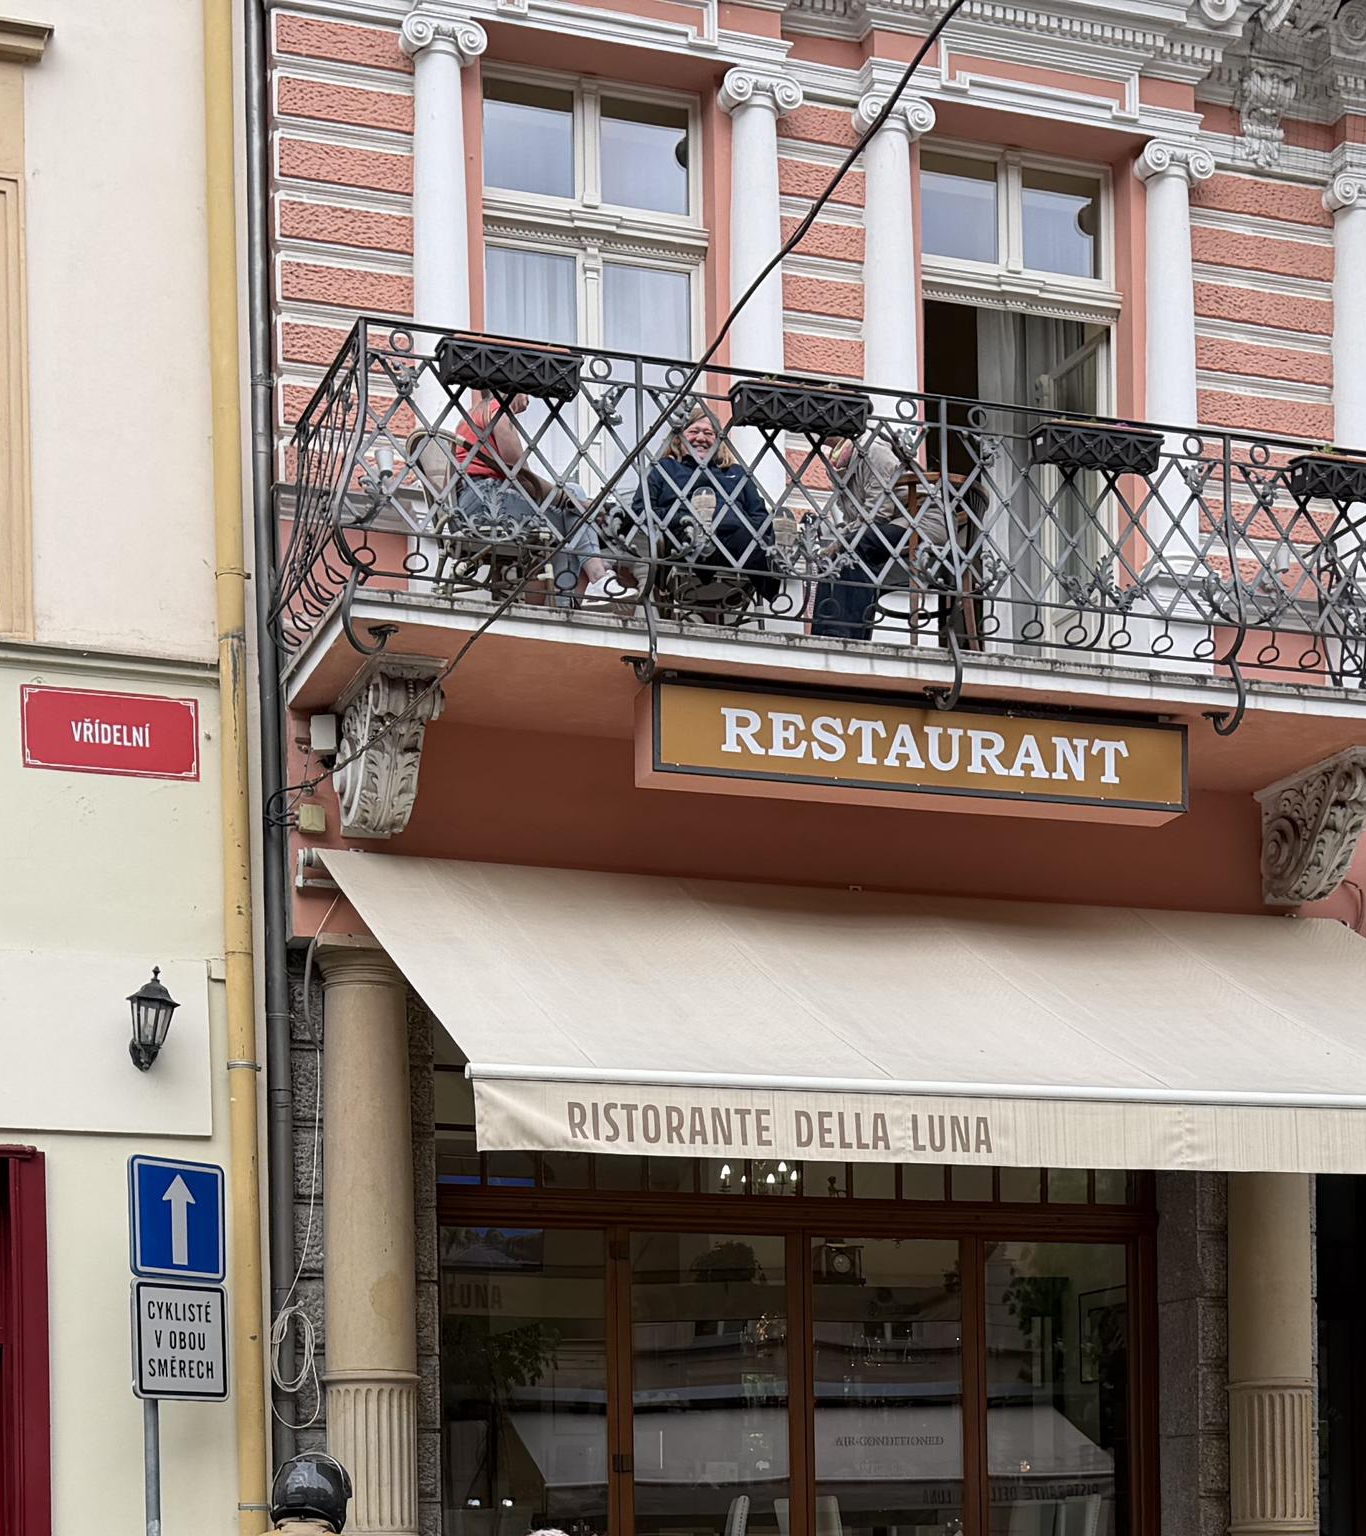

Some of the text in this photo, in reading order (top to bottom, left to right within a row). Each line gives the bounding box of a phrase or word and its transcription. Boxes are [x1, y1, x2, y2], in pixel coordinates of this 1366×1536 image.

[71, 718, 151, 748] VŘÍDELNÍ
[720, 707, 1129, 784] RESTAURANT
[567, 1101, 994, 1155] RISTORANTE DELLA LUNA
[147, 1300, 212, 1324] CYKLISTÉ
[154, 1329, 206, 1351] V OBOU
[148, 1356, 214, 1380] SMĚRECH
